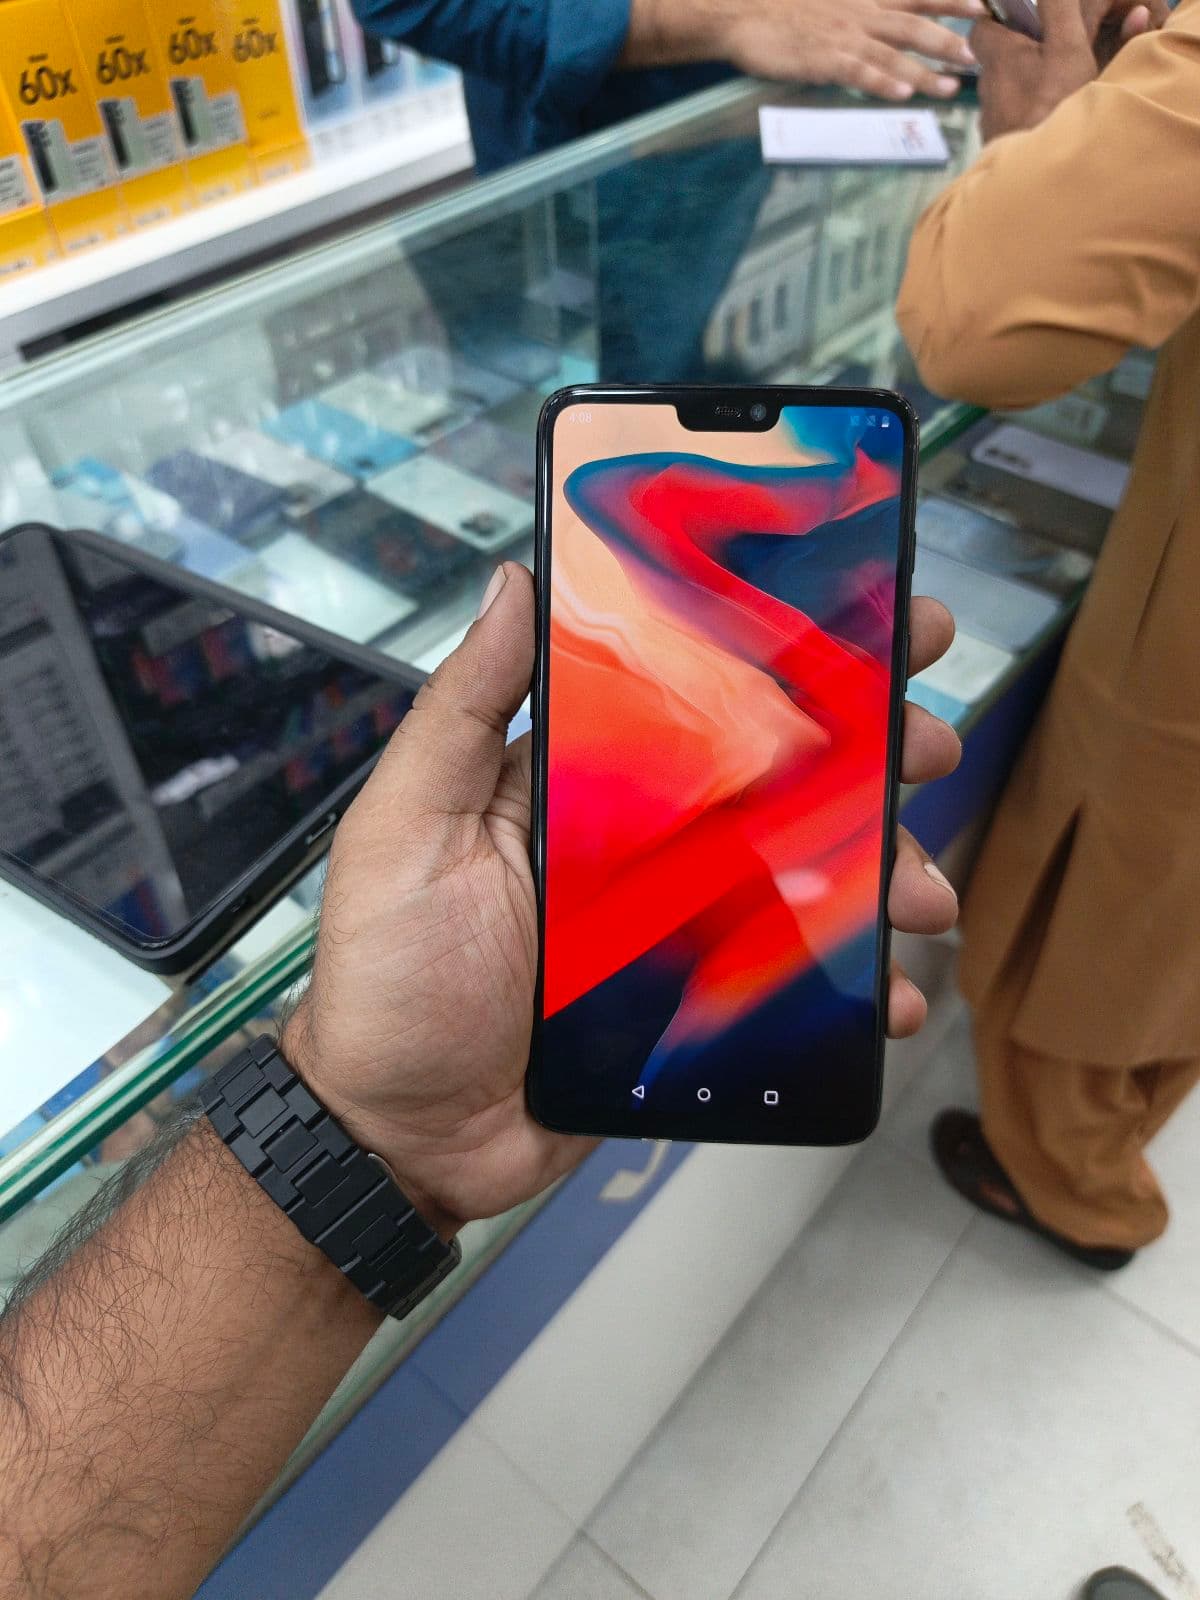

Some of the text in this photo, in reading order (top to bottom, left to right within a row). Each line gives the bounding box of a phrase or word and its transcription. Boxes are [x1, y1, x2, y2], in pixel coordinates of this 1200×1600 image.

[169, 28, 216, 64] 60x
[97, 47, 150, 84] 60x
[19, 66, 77, 105] 60x
[568, 411, 592, 424] 4:08
